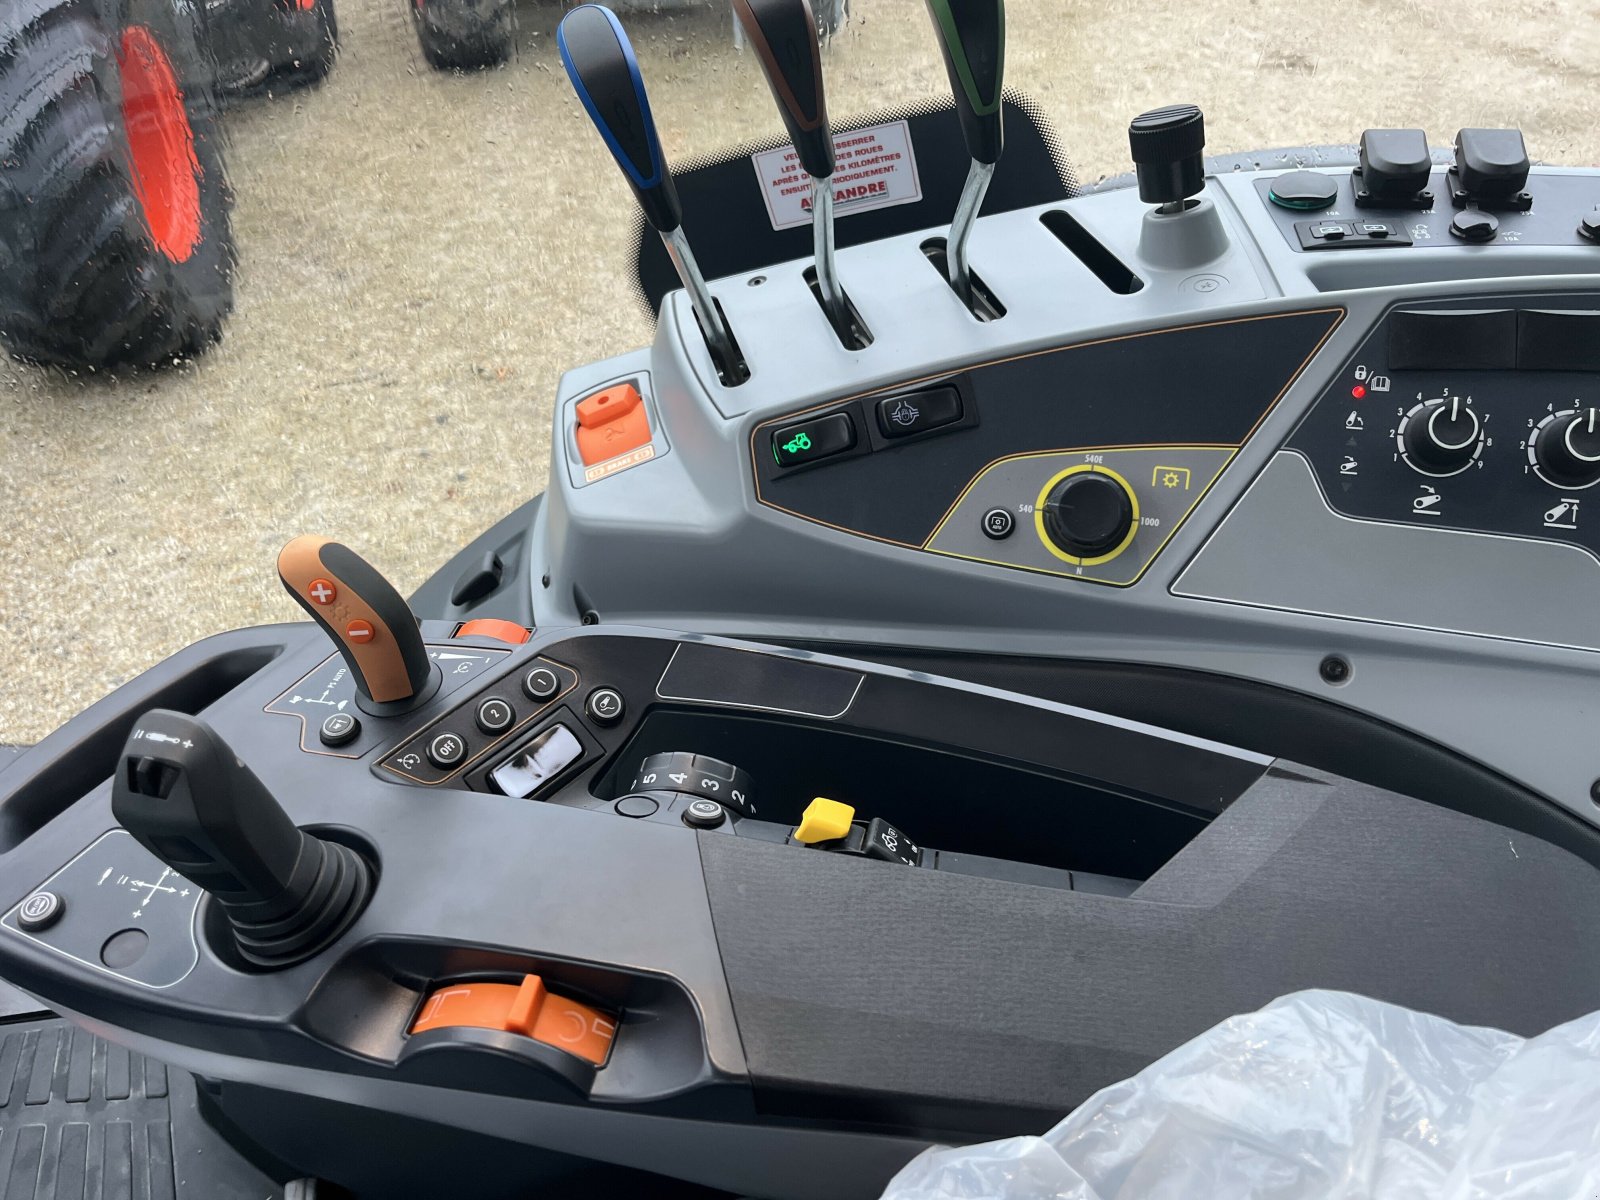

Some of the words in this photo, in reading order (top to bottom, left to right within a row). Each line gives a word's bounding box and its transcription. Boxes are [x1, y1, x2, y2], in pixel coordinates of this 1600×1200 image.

[834, 135, 875, 150] SSERRER
[836, 151, 853, 161] DES
[854, 145, 884, 157] ROUES
[781, 164, 797, 173] LES
[848, 152, 902, 169] KILOMÈTRES
[772, 174, 799, 187] APRÈS
[780, 183, 811, 196] ENSUIT
[832, 165, 898, 184] RIODIQUEMENT.
[801, 181, 886, 209] AANDRE
[1416, 392, 1422, 401] 4
[1443, 388, 1449, 397] 5
[1466, 396, 1472, 405] 6
[1574, 399, 1580, 407] 5
[1397, 407, 1403, 417] 3
[1547, 403, 1553, 411] 4
[1484, 413, 1490, 423] 7
[1527, 419, 1533, 427] 3
[1389, 429, 1395, 438] 2
[1486, 438, 1493, 447] 8
[1519, 441, 1525, 450] 2
[1084, 454, 1104, 464] 540E
[1393, 453, 1398, 462] 1
[1477, 460, 1484, 470] 9
[1524, 465, 1528, 474] 1
[1018, 504, 1033, 513] 540
[1140, 517, 1160, 527] 1000
[1076, 566, 1082, 575] N
[333, 668, 347, 682] AUTO
[537, 678, 547, 686] 1
[490, 708, 500, 719] 2
[439, 739, 456, 756] OFF
[642, 773, 657, 784] 5
[668, 772, 688, 784] 4
[701, 778, 720, 791] 3
[731, 789, 745, 806] 2
